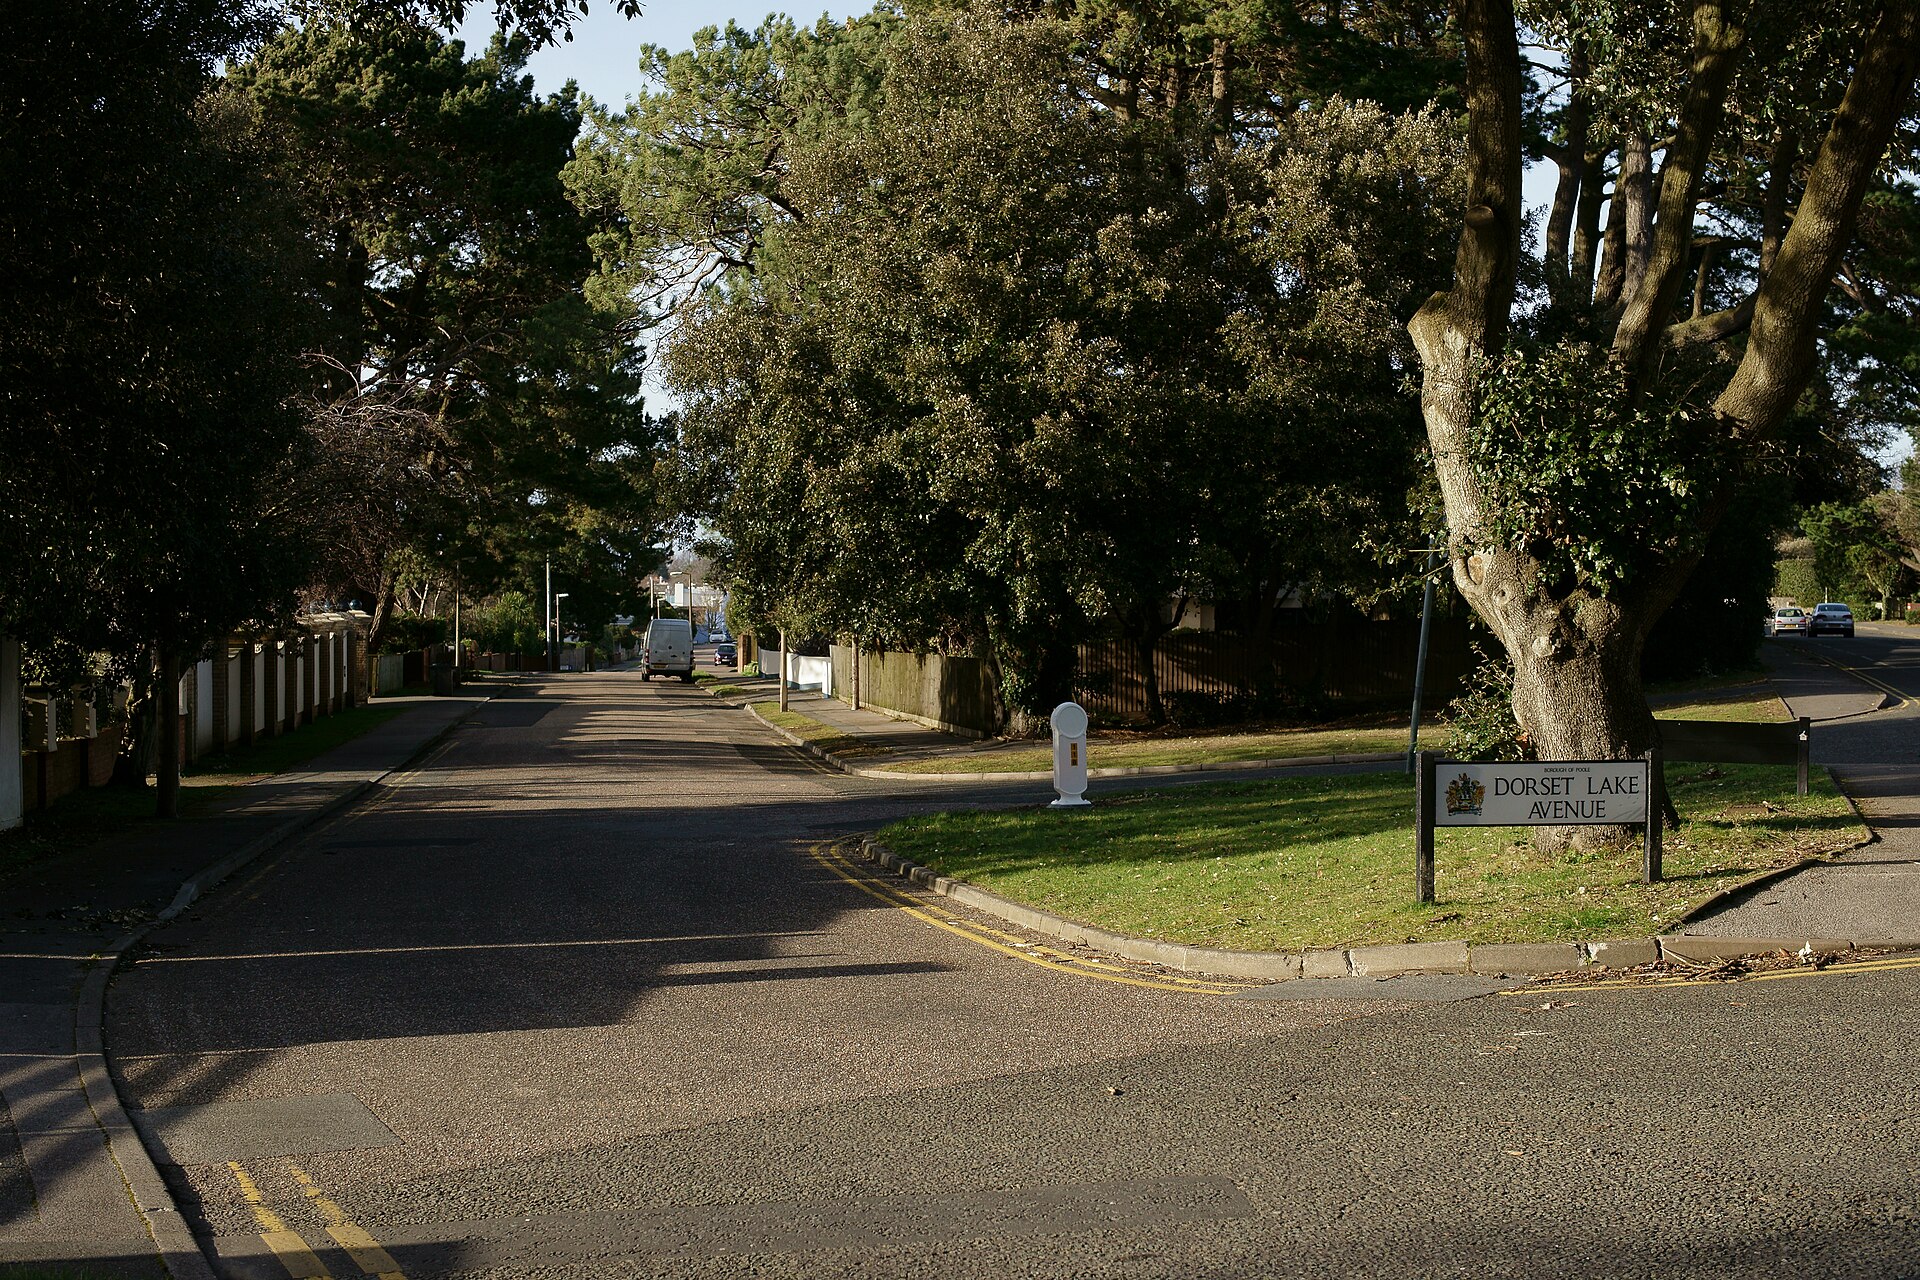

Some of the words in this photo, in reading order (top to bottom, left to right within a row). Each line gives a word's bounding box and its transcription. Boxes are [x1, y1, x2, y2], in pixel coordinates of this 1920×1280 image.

[1494, 777, 1575, 796] DORSET
[1587, 776, 1640, 795] LAKE
[1528, 800, 1607, 819] AVENUE
